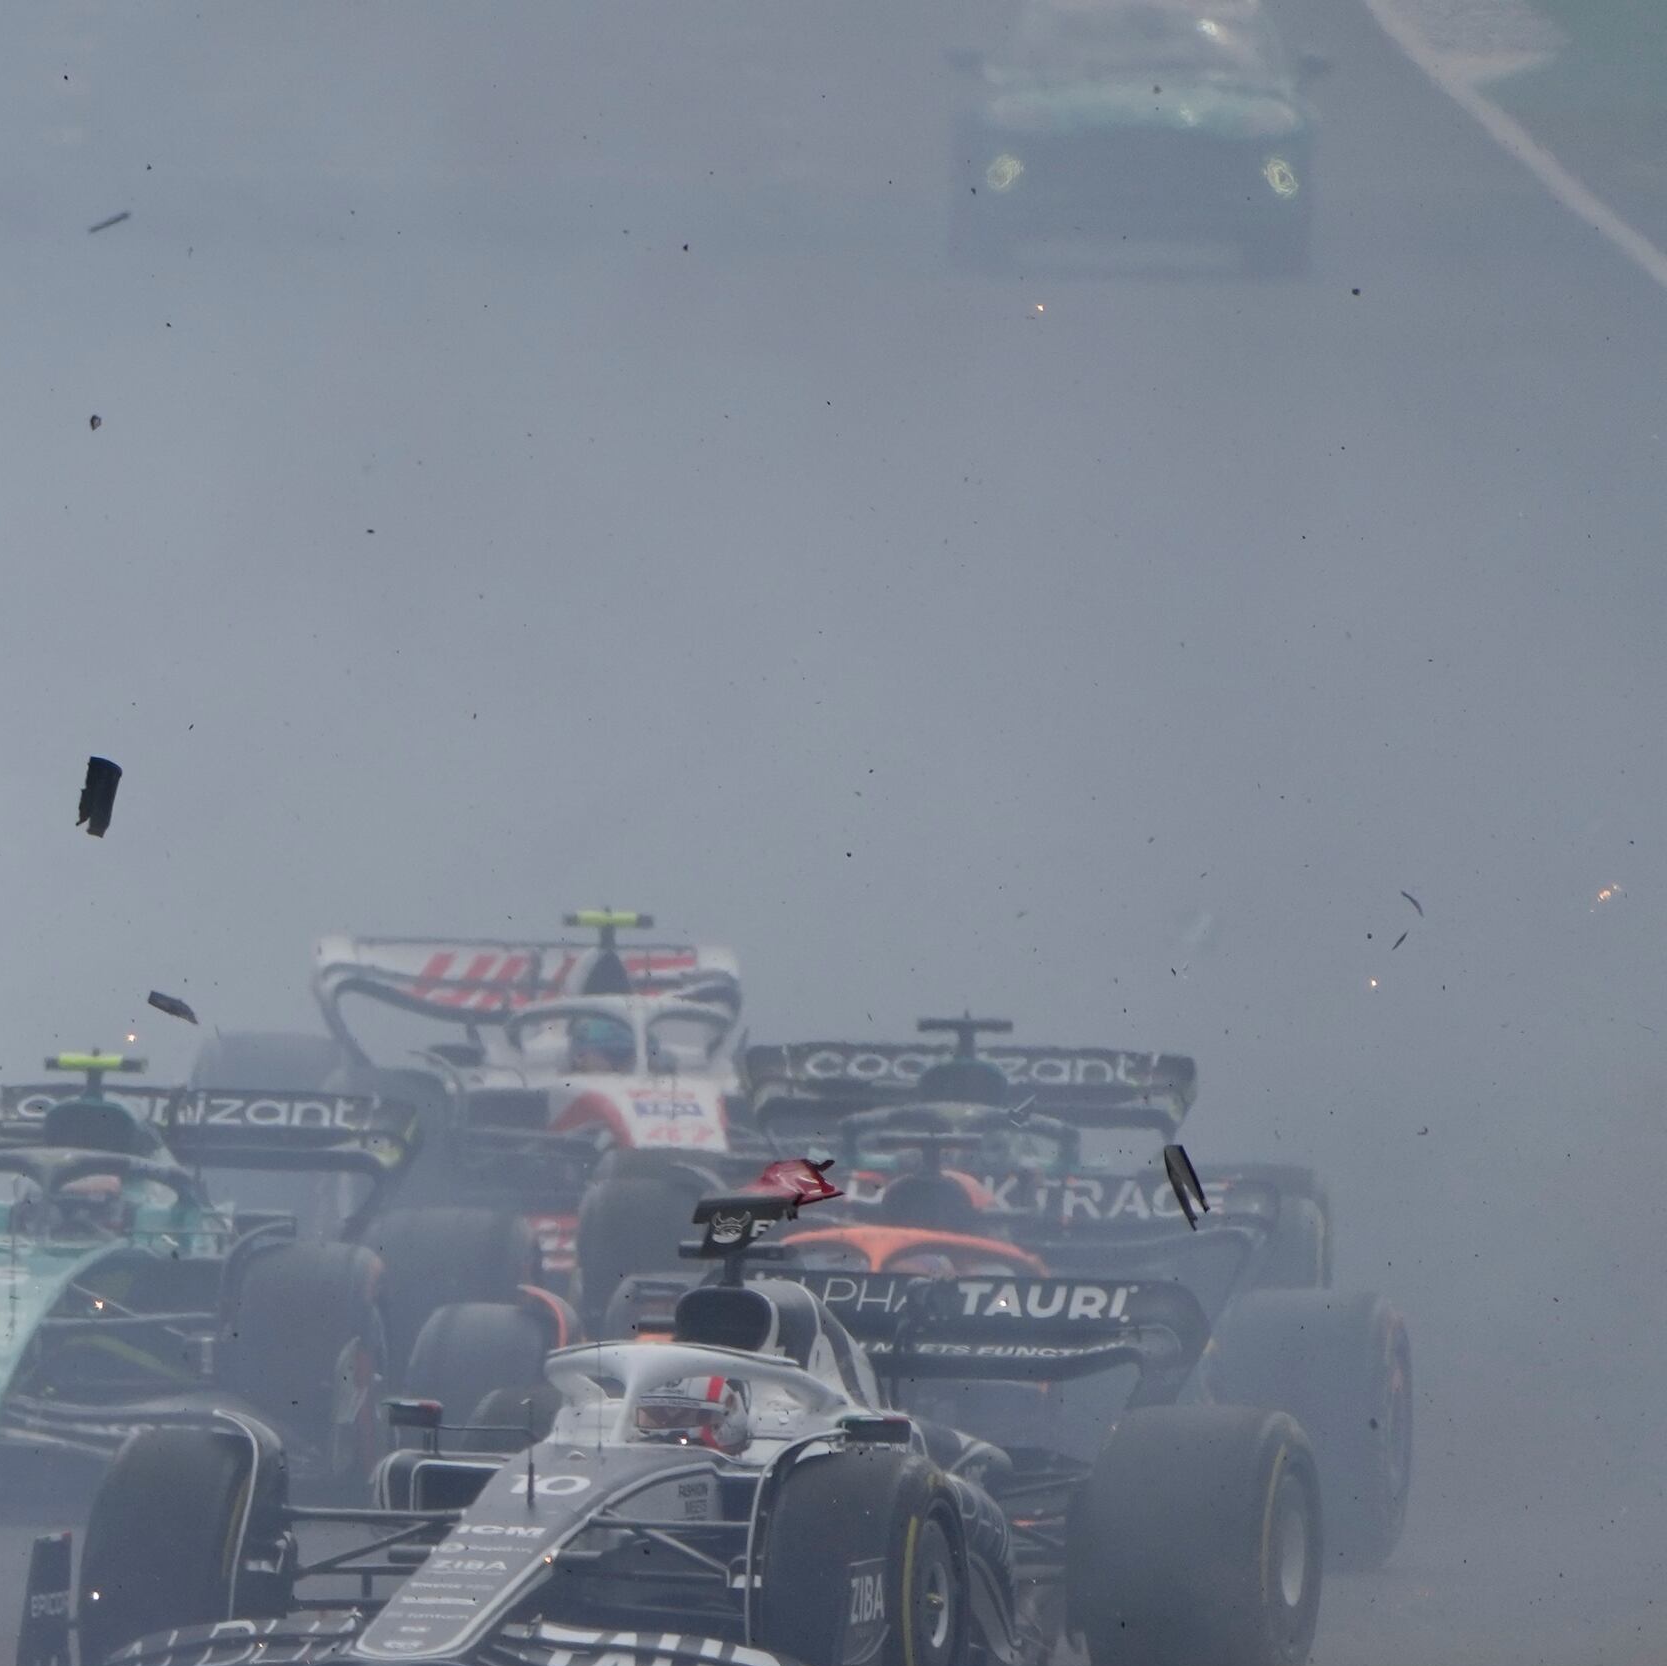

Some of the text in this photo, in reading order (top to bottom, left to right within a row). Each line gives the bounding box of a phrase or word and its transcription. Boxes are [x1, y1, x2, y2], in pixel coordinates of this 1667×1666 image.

[958, 1281, 1130, 1320] TAURI
[510, 1474, 592, 1496] 10
[431, 1559, 508, 1571] ZIBA
[850, 1572, 886, 1625] ZIBA
